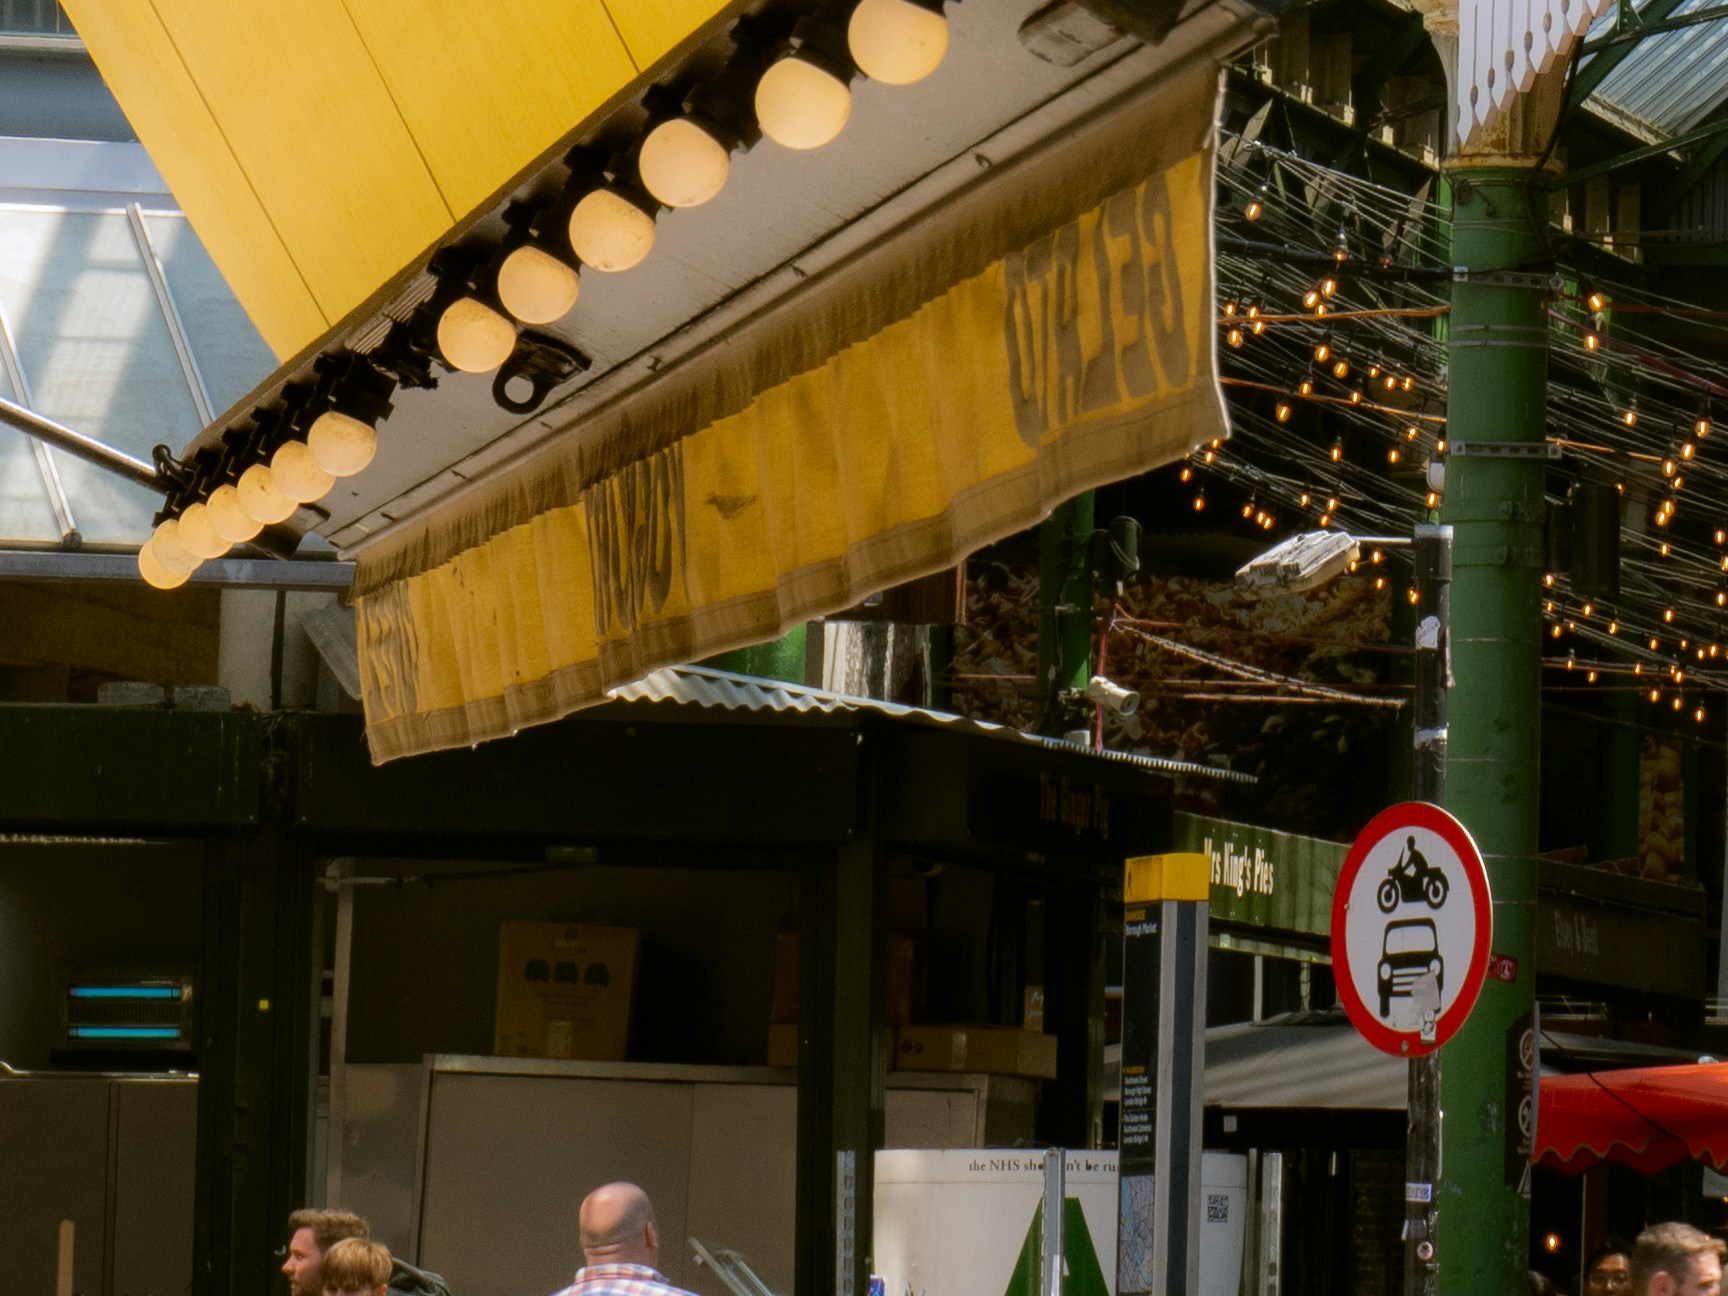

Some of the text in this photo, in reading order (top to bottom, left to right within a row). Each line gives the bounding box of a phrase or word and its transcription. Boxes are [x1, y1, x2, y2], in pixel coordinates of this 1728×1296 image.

[1223, 841, 1252, 898] King's
[1254, 847, 1274, 895] Pies
[969, 1160, 987, 1171] the
[989, 1159, 1020, 1171] NHS
[1085, 1159, 1099, 1171] be
[1103, 1160, 1119, 1172] ru
